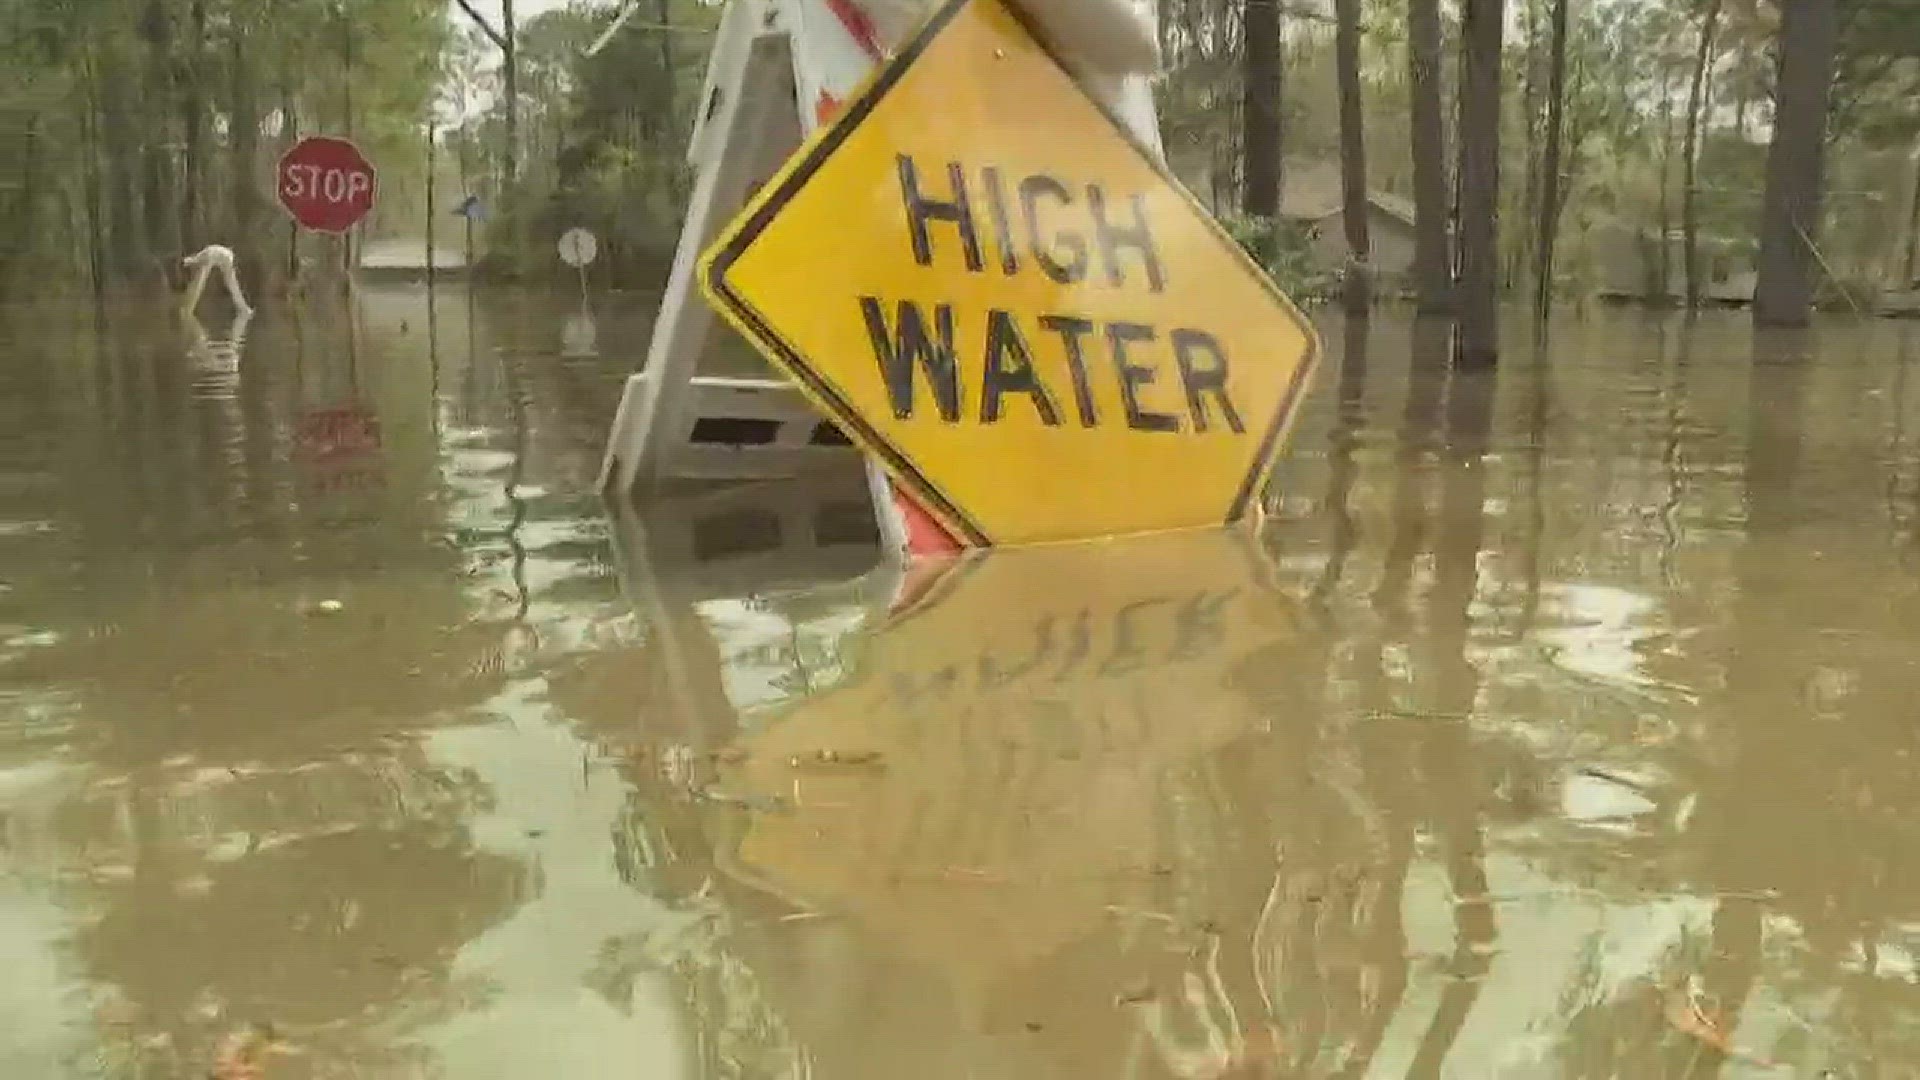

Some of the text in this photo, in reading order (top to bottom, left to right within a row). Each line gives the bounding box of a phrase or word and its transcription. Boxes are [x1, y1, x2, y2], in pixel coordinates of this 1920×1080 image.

[284, 164, 369, 203] STOP
[895, 152, 1166, 294] HIGH
[859, 295, 1247, 435] WATER
